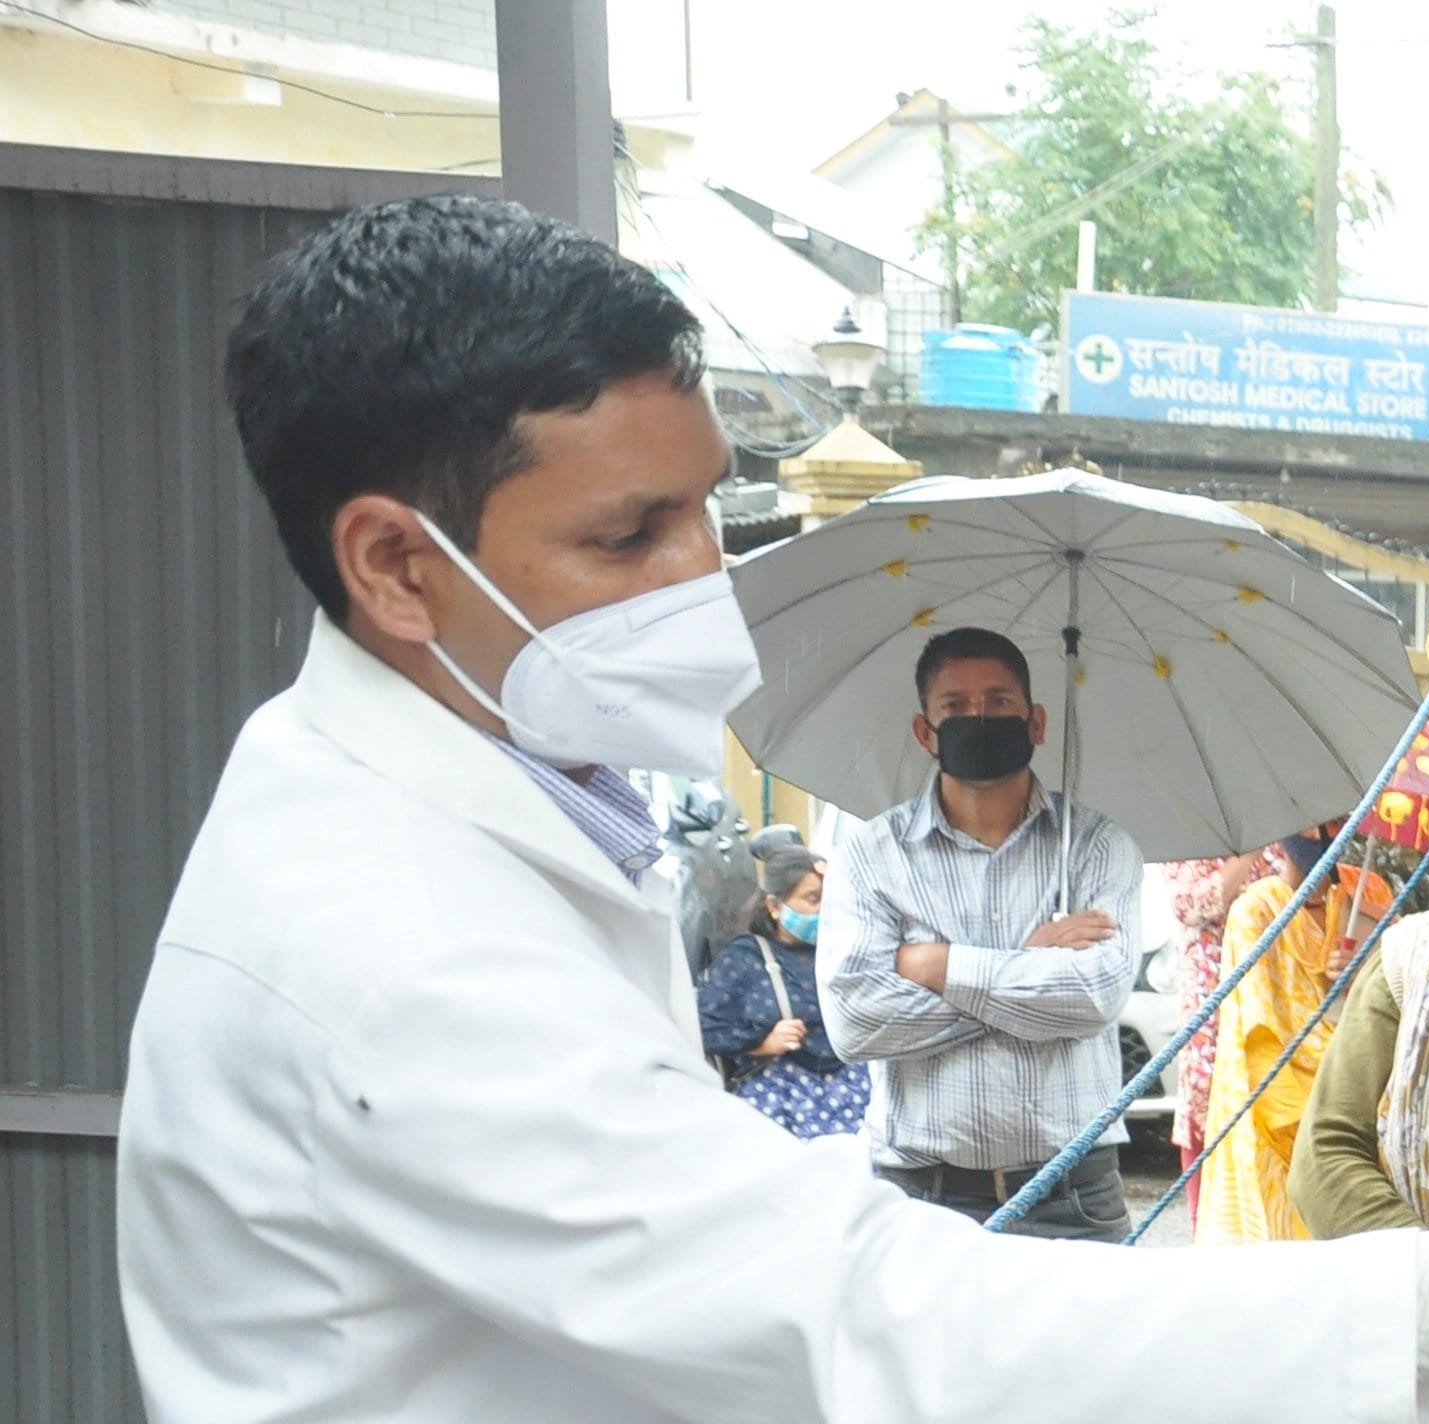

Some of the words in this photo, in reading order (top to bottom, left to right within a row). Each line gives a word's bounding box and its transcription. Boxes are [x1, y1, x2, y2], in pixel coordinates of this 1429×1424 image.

[1124, 330, 1221, 375] सन्तोष
[1234, 336, 1350, 386] मेडिकल
[1364, 350, 1426, 394] स्टोर
[1129, 373, 1238, 406] SANTOSH
[1245, 384, 1350, 415] MEDICAL
[1357, 393, 1427, 421] STORE
